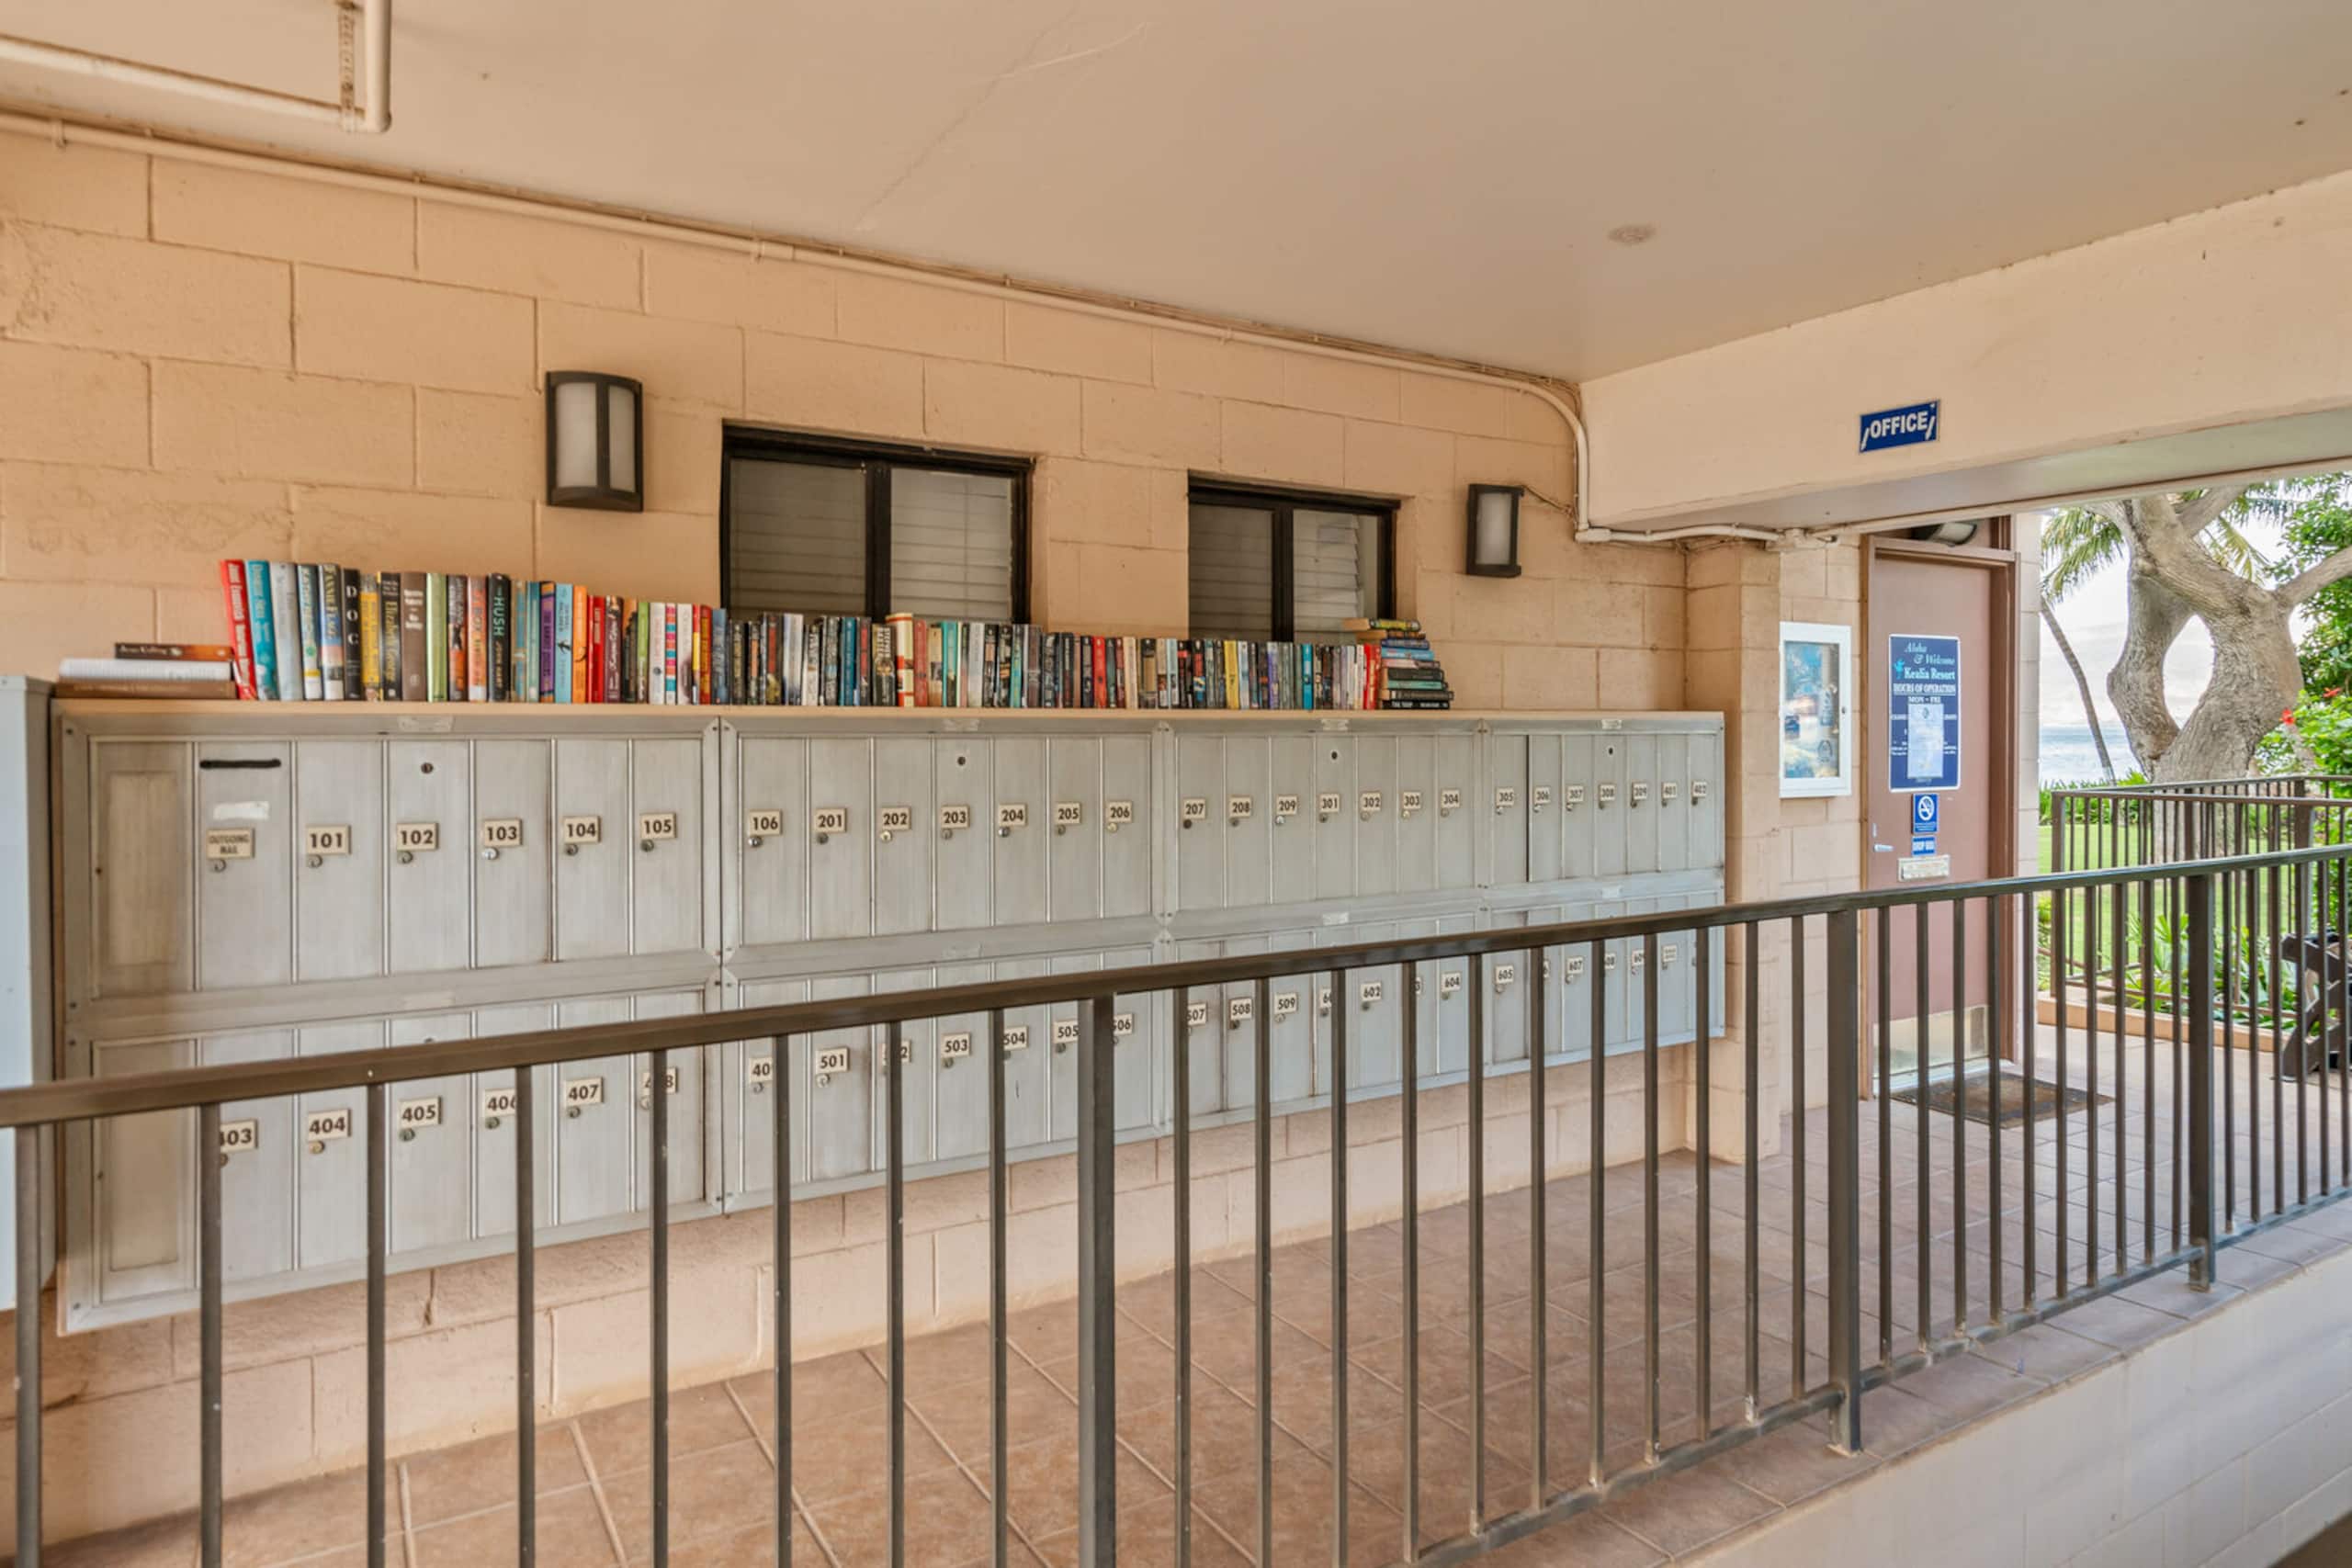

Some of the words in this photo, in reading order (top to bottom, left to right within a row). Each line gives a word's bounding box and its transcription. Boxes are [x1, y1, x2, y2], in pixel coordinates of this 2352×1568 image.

[1870, 411, 1928, 438] OFFICE
[492, 596, 505, 637] HUSH
[385, 601, 398, 648] Elizabeth
[1926, 653, 1956, 665] Welcome
[1930, 667, 1956, 680] Resort
[1924, 683, 1956, 694] OPERATION
[1443, 794, 1459, 804] 304
[1498, 792, 1513, 802] 305
[1536, 791, 1549, 800] 306
[1569, 789, 1583, 799] 307
[1232, 802, 1250, 813] 208
[1279, 800, 1296, 811] 209
[1322, 798, 1338, 809] 301
[1363, 797, 1381, 807] 302
[1404, 795, 1419, 807] 303
[1001, 809, 1024, 822] 204
[1057, 807, 1079, 820] 205
[1109, 807, 1130, 818] 206
[1185, 804, 1204, 815] 207
[752, 816, 778, 830] 106
[818, 814, 842, 828] 201
[883, 812, 908, 826] 202
[944, 811, 967, 824] 203
[566, 822, 596, 837] 104
[644, 819, 672, 834] 105
[310, 833, 344, 848] 101
[400, 830, 434, 844] 102
[487, 827, 517, 841] 103
[1498, 969, 1513, 980] 605
[1445, 976, 1460, 987] 604
[1232, 1003, 1250, 1016] 508
[1278, 998, 1295, 1010] 509
[1058, 1025, 1080, 1038] 505
[1002, 1032, 1024, 1045] 504
[944, 1039, 967, 1053] 503
[820, 1055, 844, 1068] 501
[752, 1063, 771, 1077] 40
[645, 1074, 674, 1088] 48
[569, 1084, 599, 1100] 407
[401, 1105, 435, 1122] 405
[309, 1117, 345, 1134] 404
